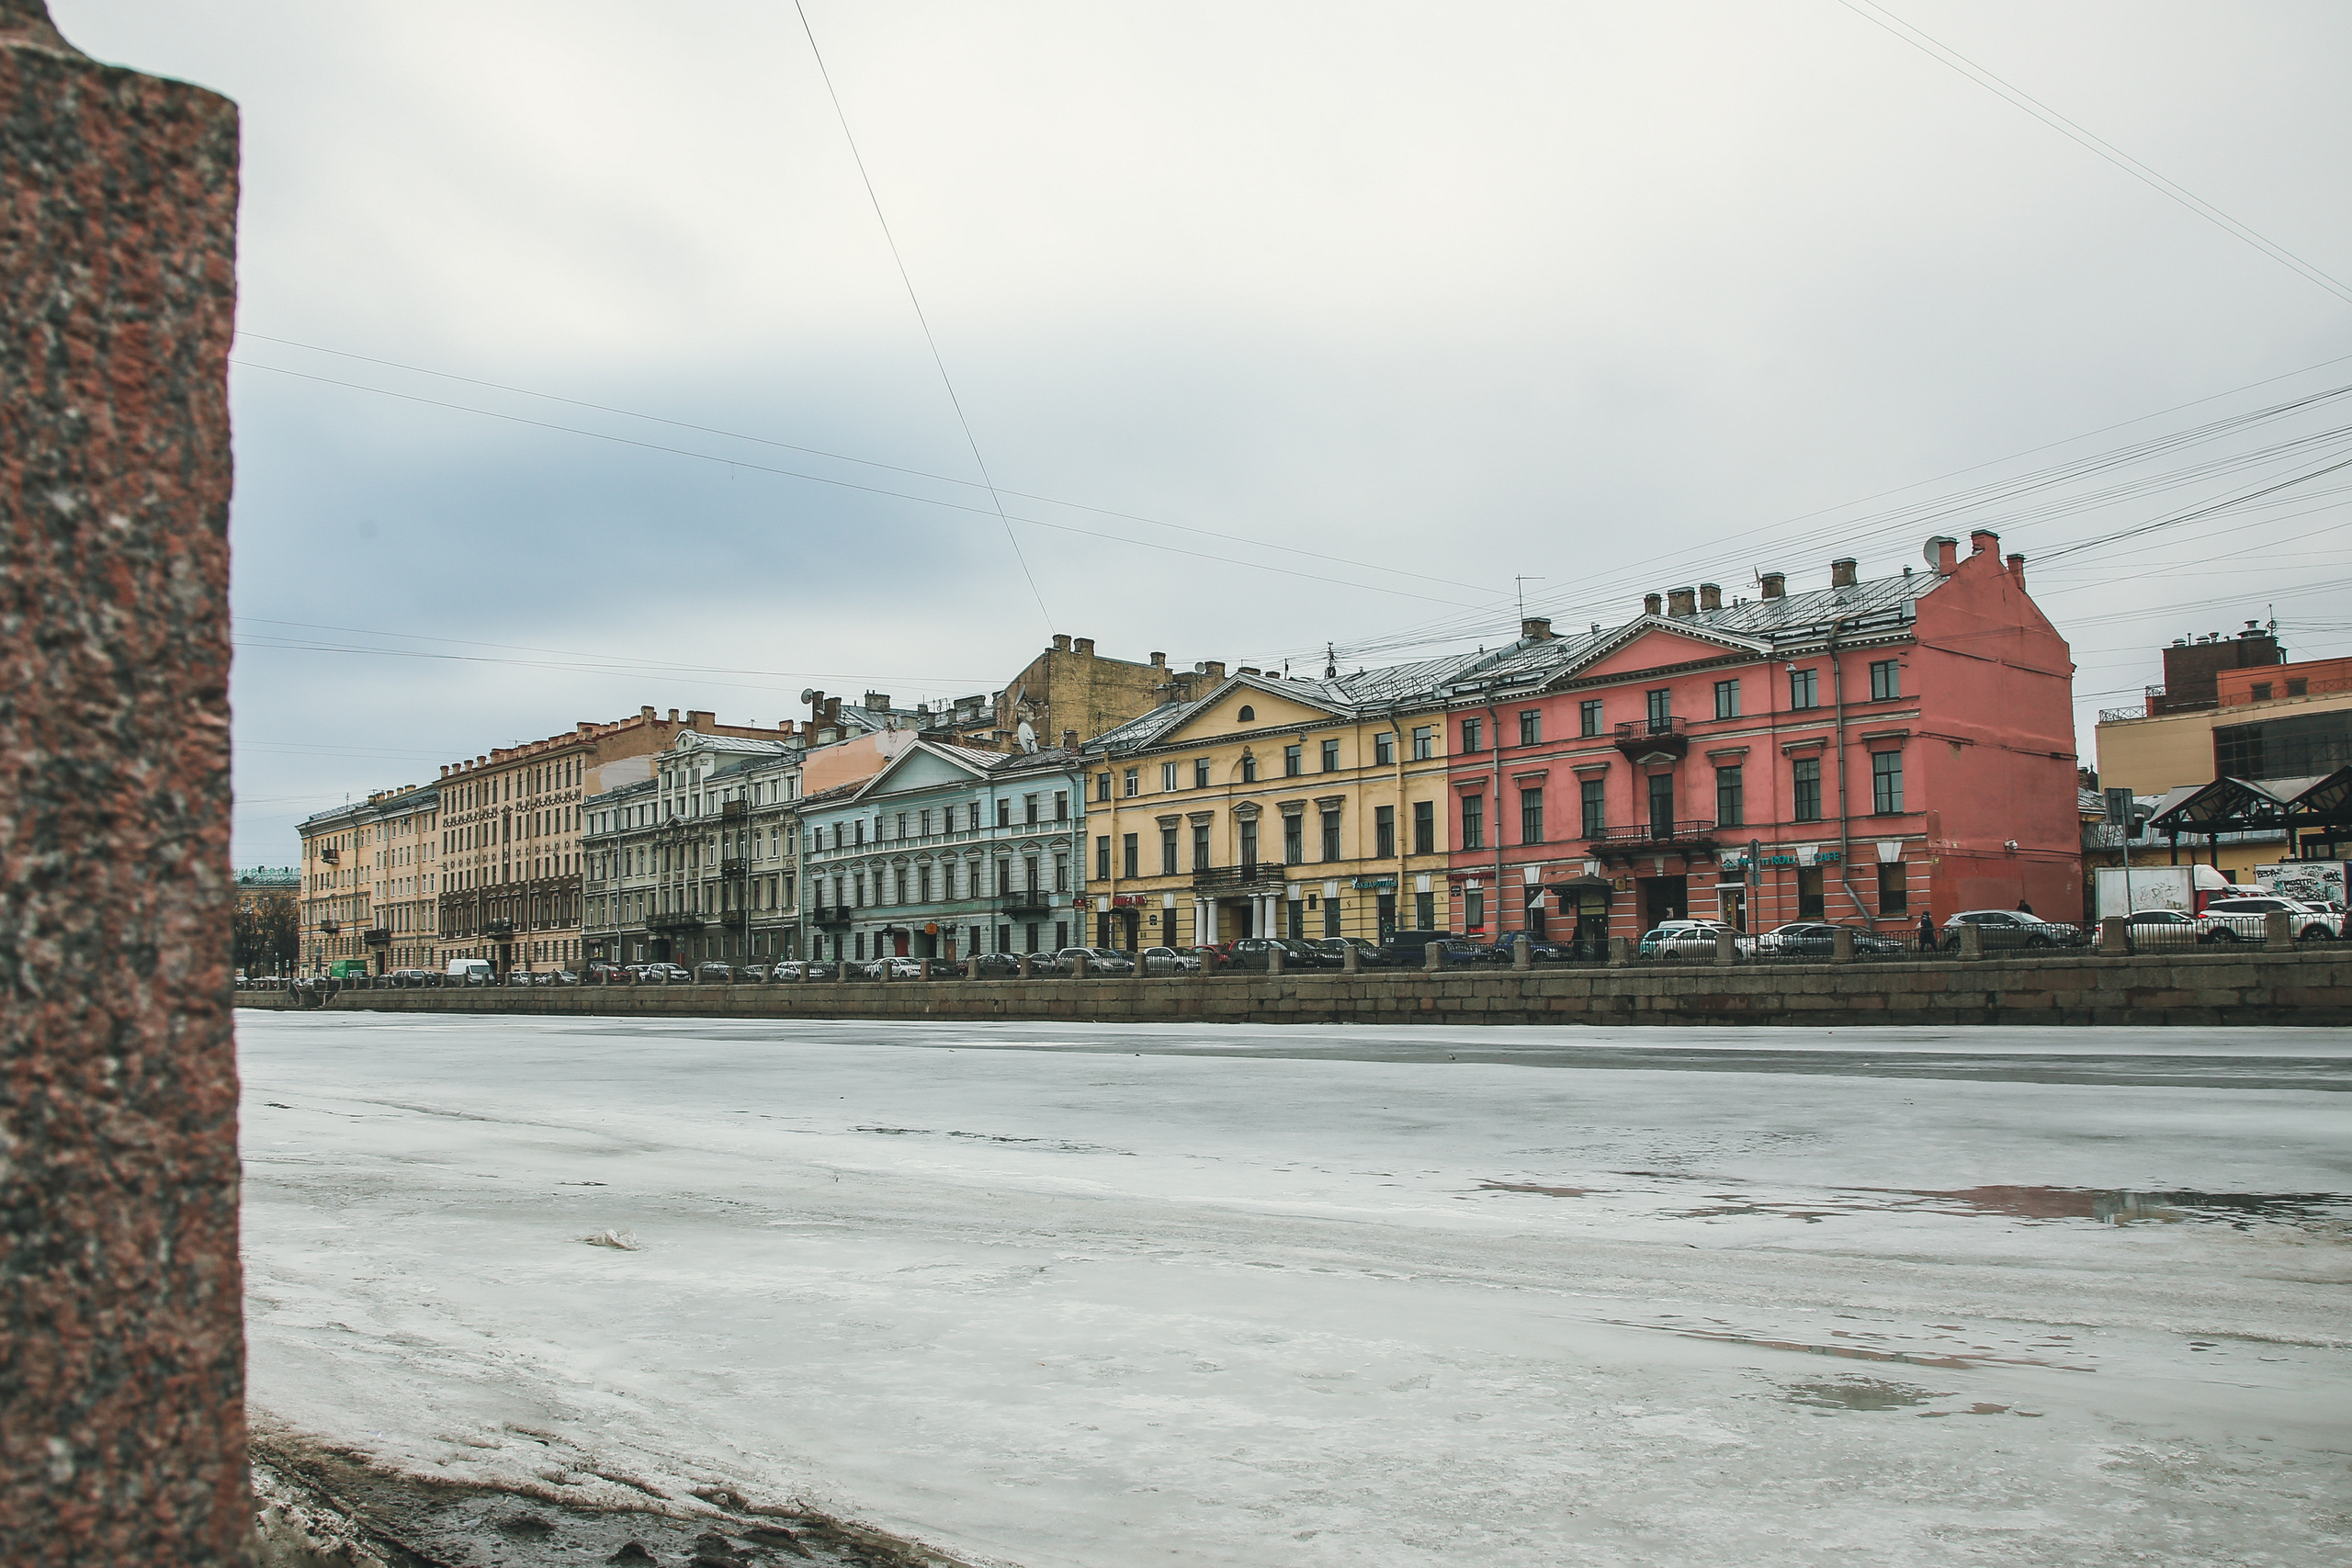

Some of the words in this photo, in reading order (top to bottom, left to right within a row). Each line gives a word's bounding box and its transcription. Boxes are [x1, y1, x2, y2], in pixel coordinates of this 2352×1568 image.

[1771, 854, 1798, 865] ROLL
[1813, 851, 1840, 863] CAFE
[1356, 879, 1398, 889] АКВАРИУМЫ
